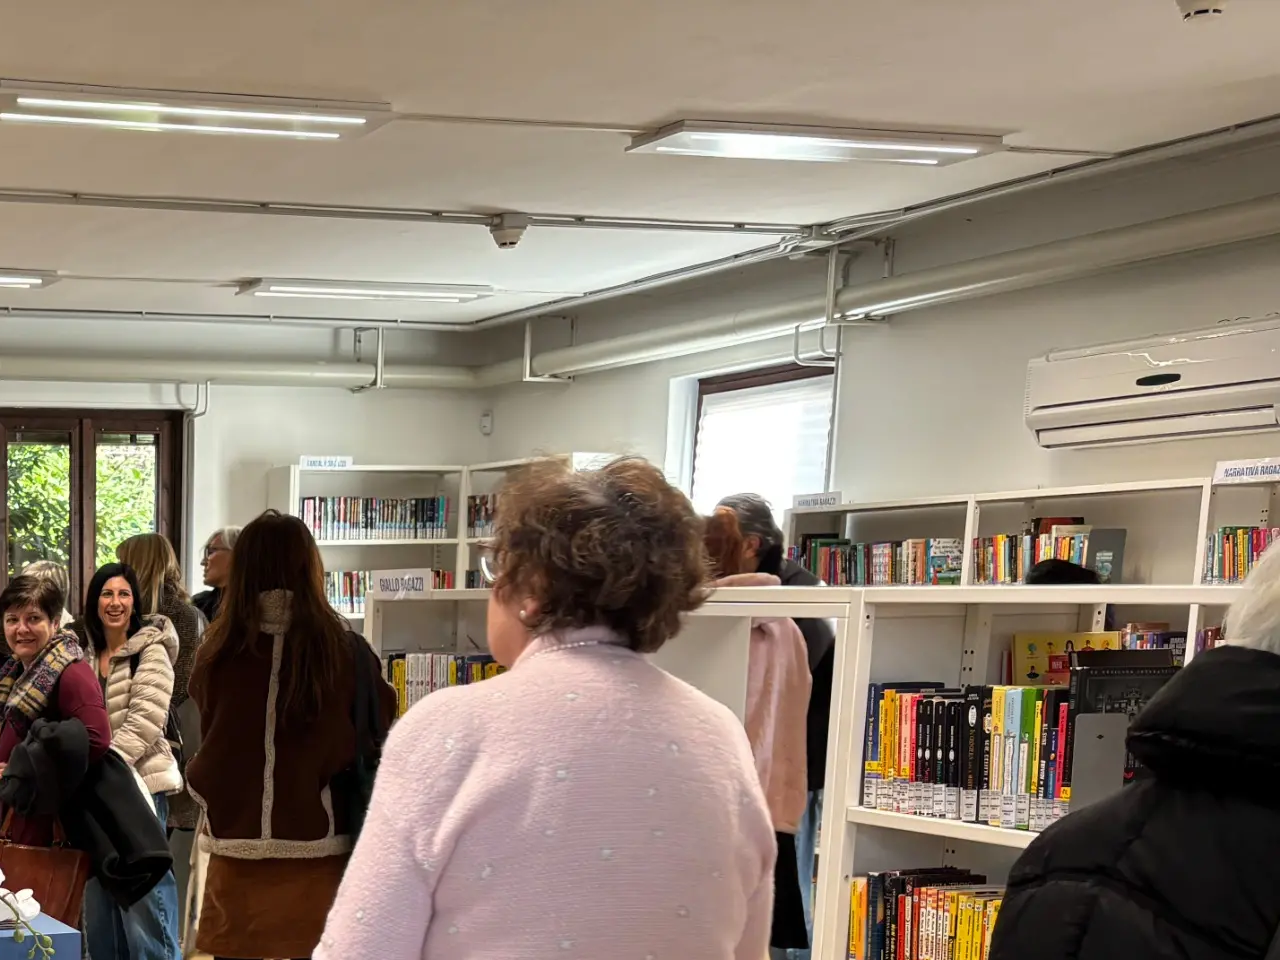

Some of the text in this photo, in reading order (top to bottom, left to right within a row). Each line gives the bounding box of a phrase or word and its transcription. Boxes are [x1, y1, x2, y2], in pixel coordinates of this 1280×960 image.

[1224, 467, 1259, 478] NARRATIVA
[380, 577, 424, 592] GIALLO RAGAZZI
